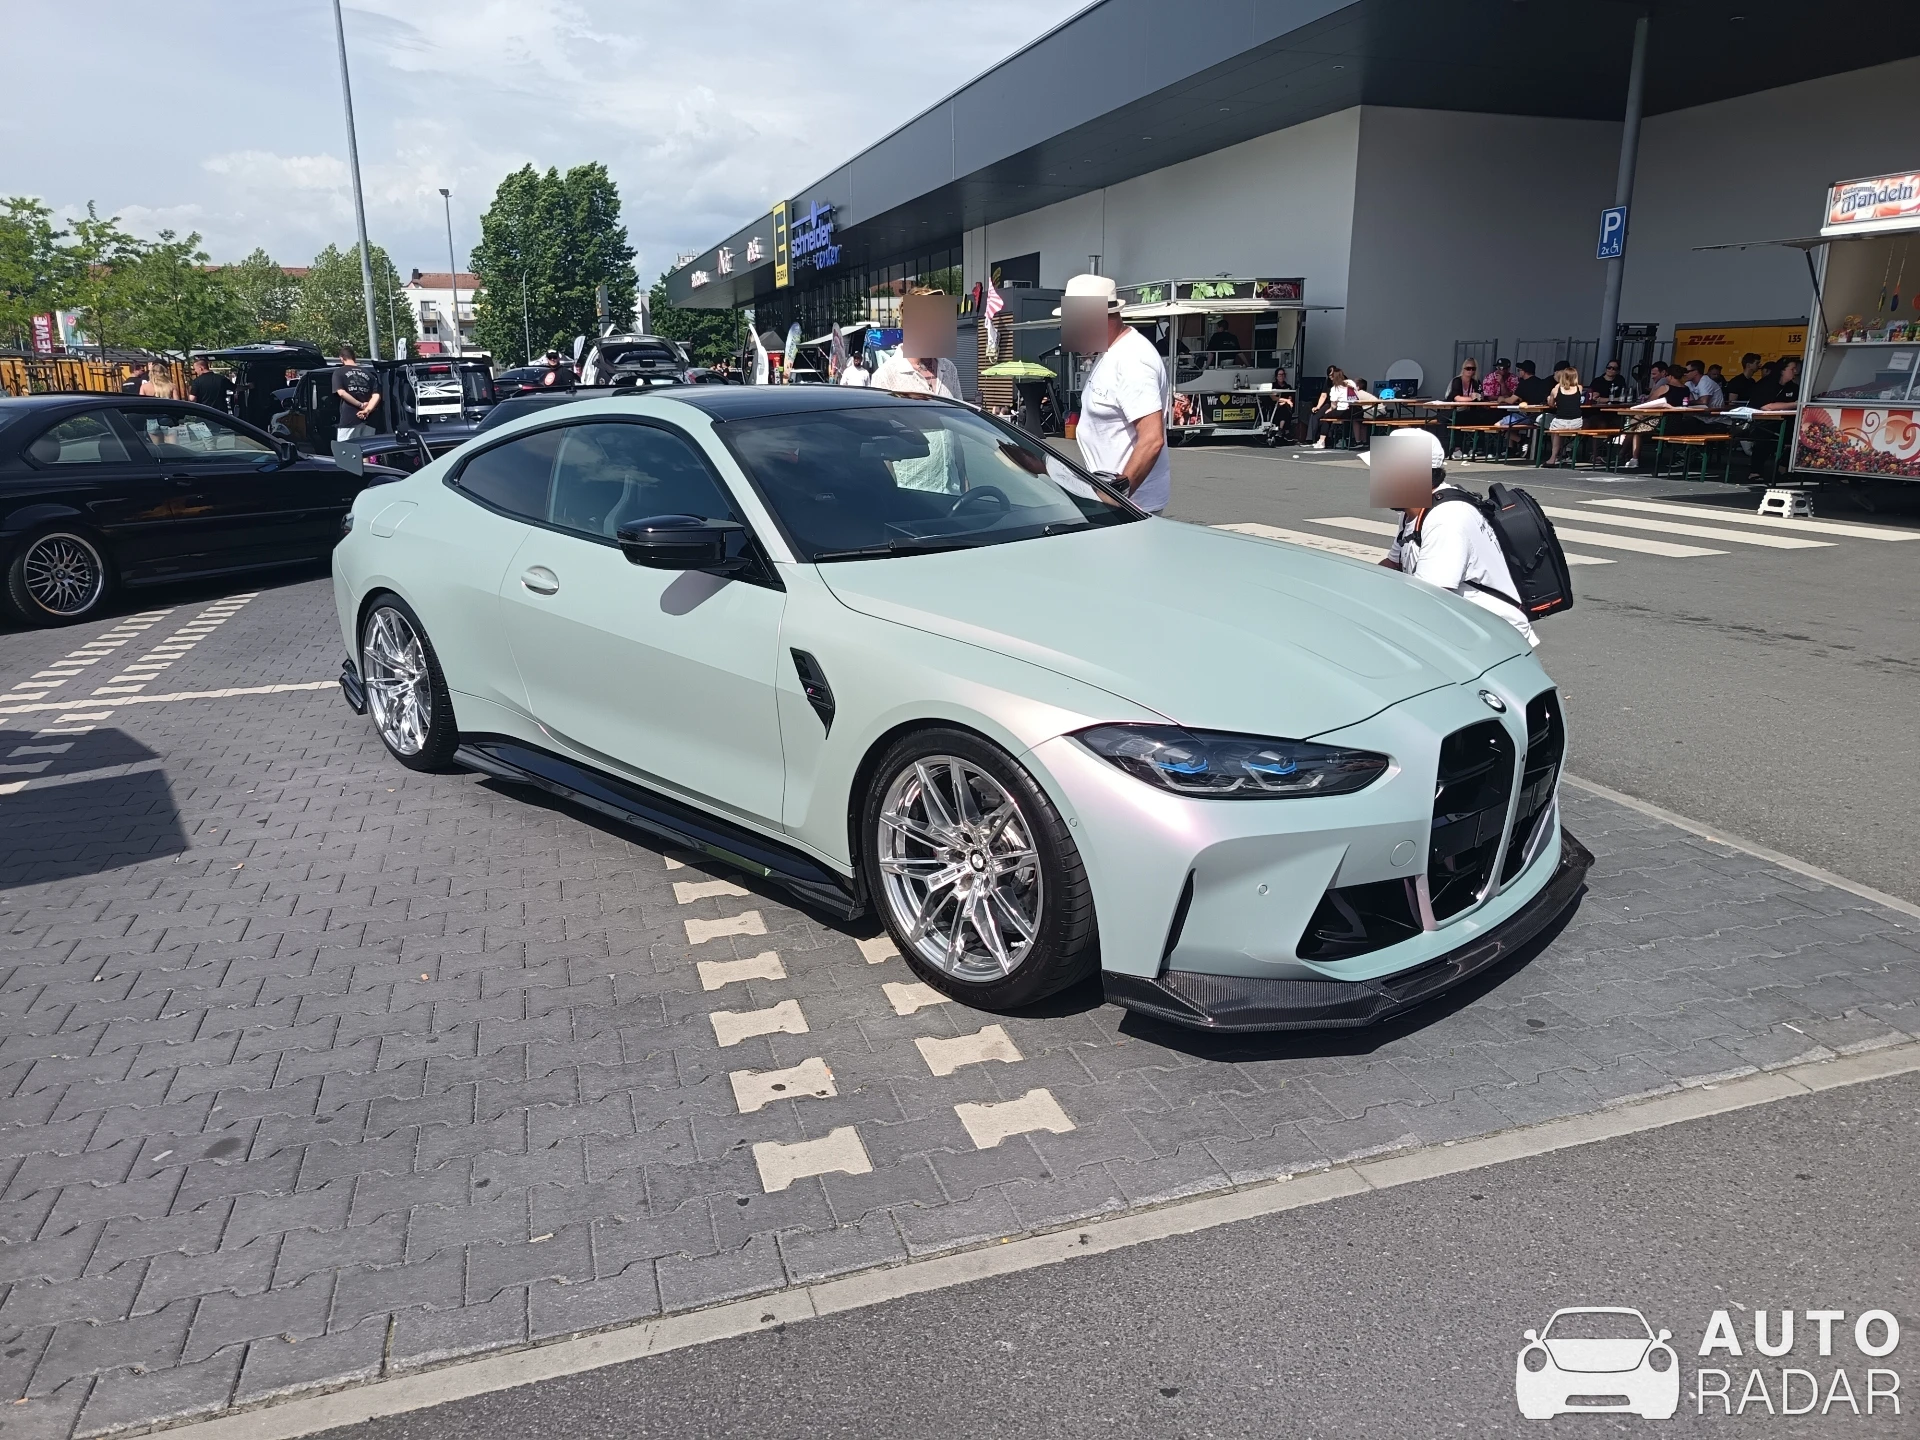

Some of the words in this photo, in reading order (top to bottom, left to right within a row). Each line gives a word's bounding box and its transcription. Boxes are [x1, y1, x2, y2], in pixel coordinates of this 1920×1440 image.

[1841, 182, 1912, 214] Mandeln
[1602, 211, 1621, 244] P
[791, 218, 832, 258] schneider
[1601, 246, 1610, 255] 2x
[1687, 335, 1727, 346] DHL
[1788, 334, 1802, 343] 135
[1206, 395, 1219, 406] Wir
